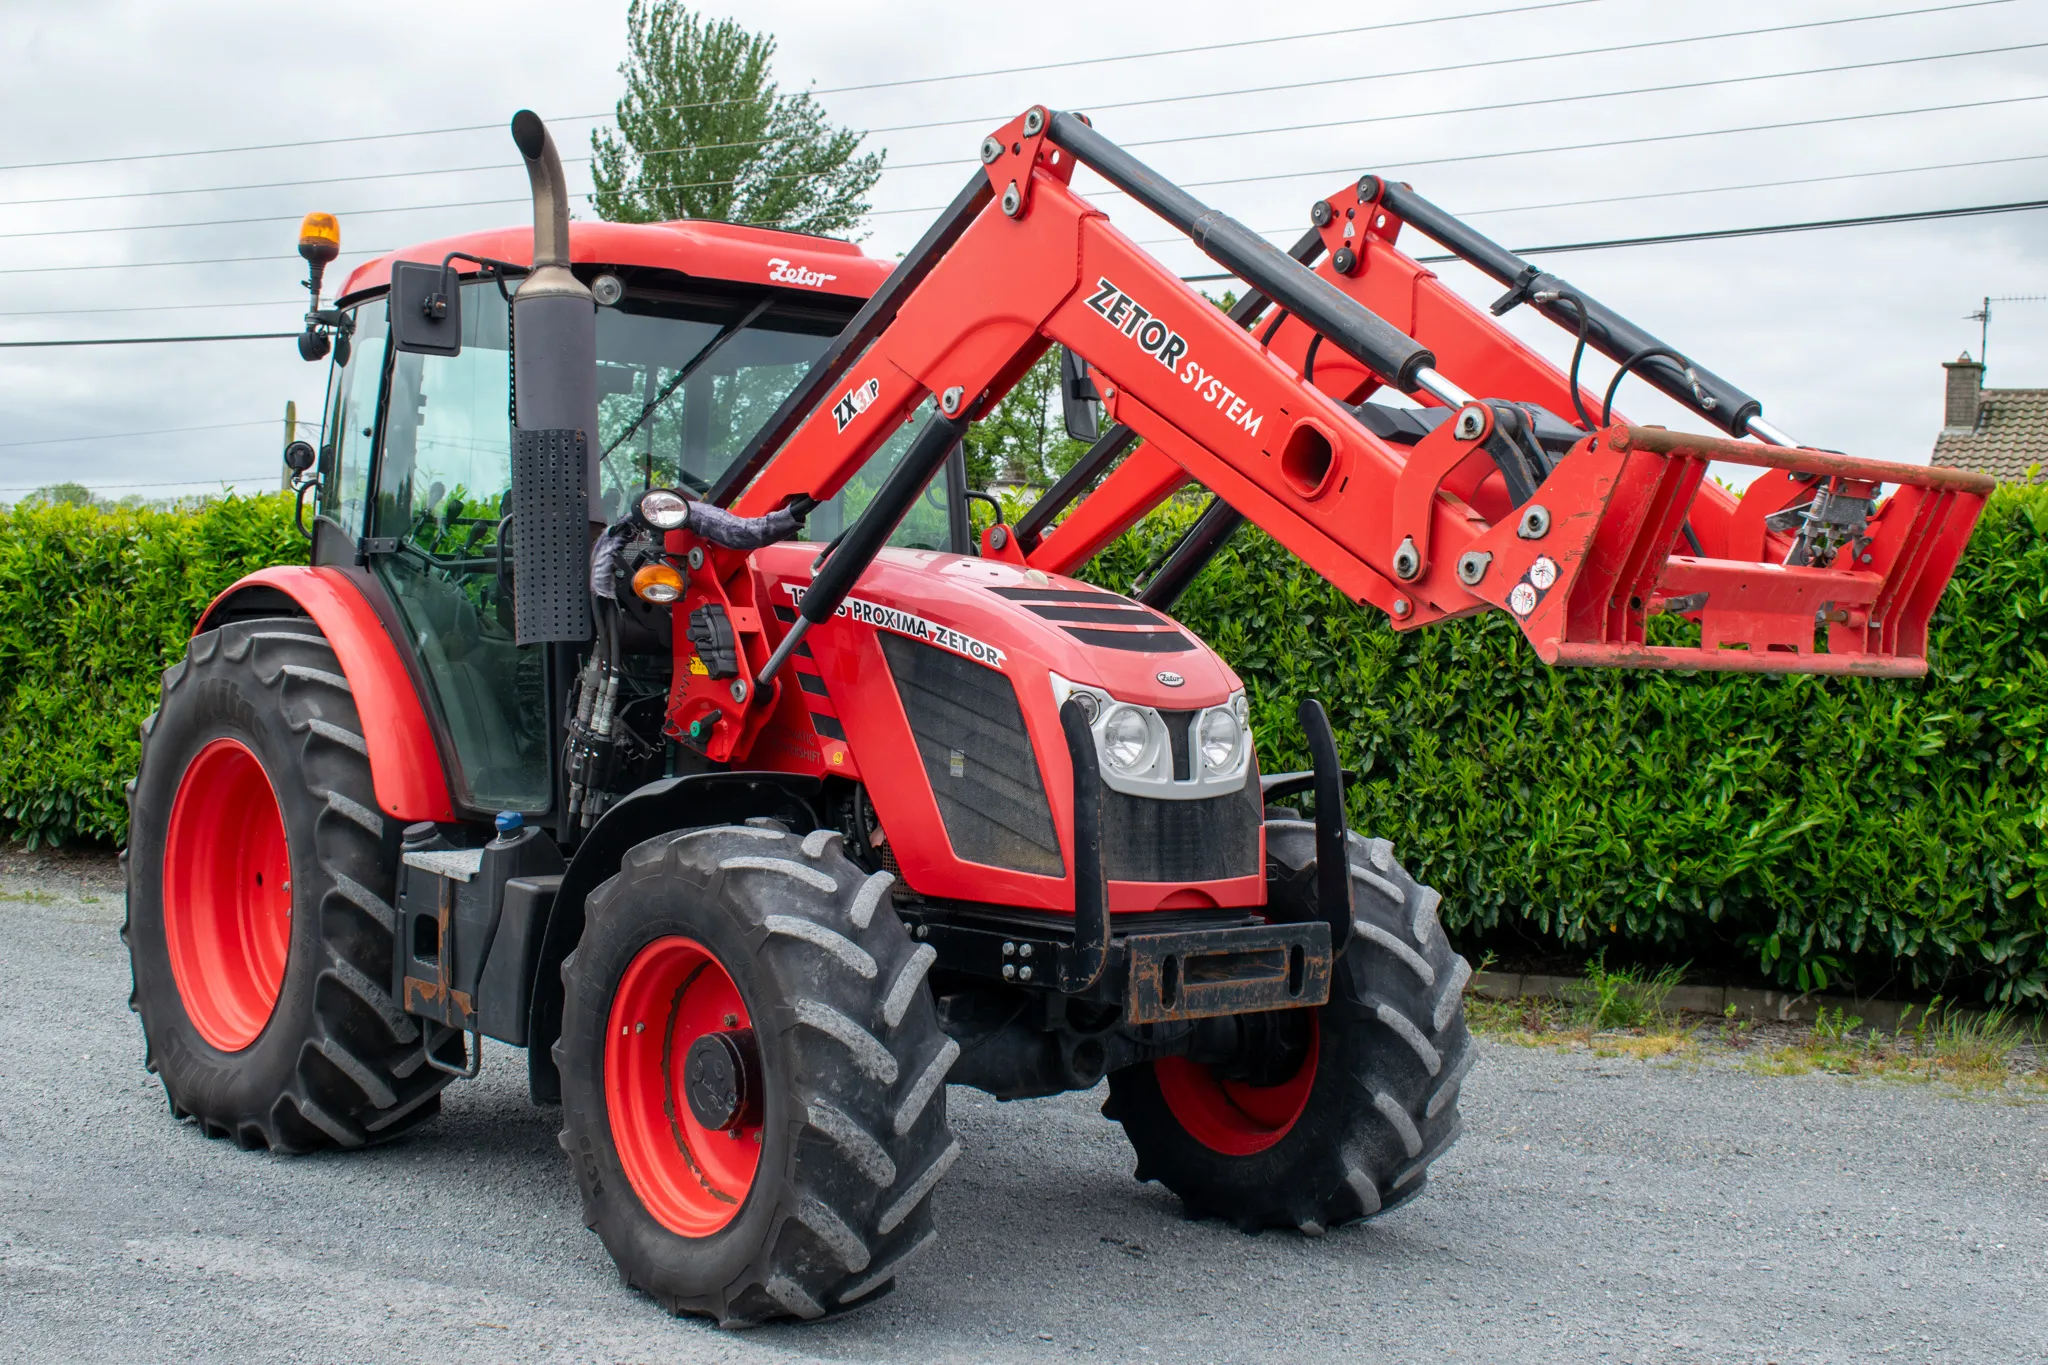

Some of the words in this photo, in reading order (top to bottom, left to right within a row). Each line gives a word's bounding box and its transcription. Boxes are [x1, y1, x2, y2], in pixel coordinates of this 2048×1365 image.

[767, 258, 837, 287] Zetor
[1083, 276, 1188, 374] ZETOR
[1180, 361, 1264, 437] SYSTEM
[852, 600, 930, 639] PROXIMA
[933, 626, 1001, 668] ZETOR
